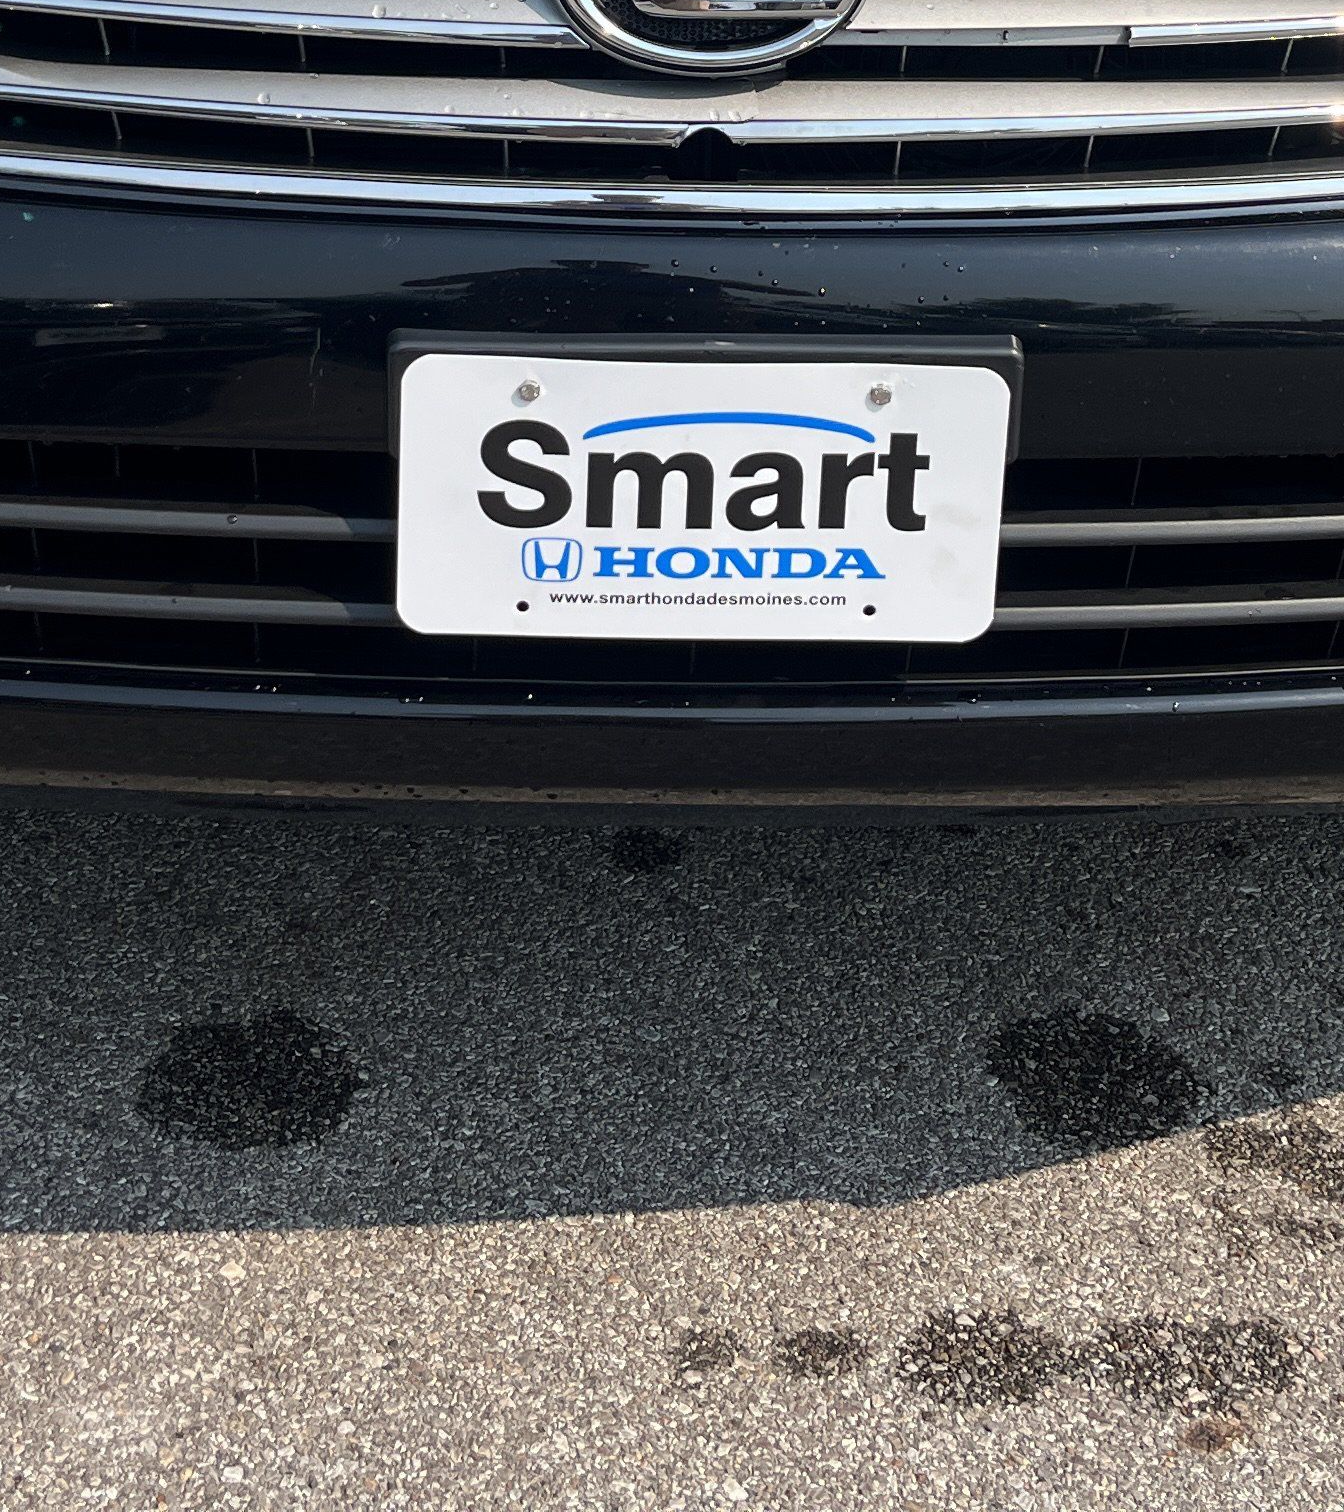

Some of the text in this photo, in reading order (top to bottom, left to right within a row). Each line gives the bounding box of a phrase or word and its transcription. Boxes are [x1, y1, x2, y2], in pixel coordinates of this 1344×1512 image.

[476, 419, 931, 532] Smart
[592, 546, 886, 580] HONDA
[549, 591, 847, 607] www.smarthondadesmoines.com
